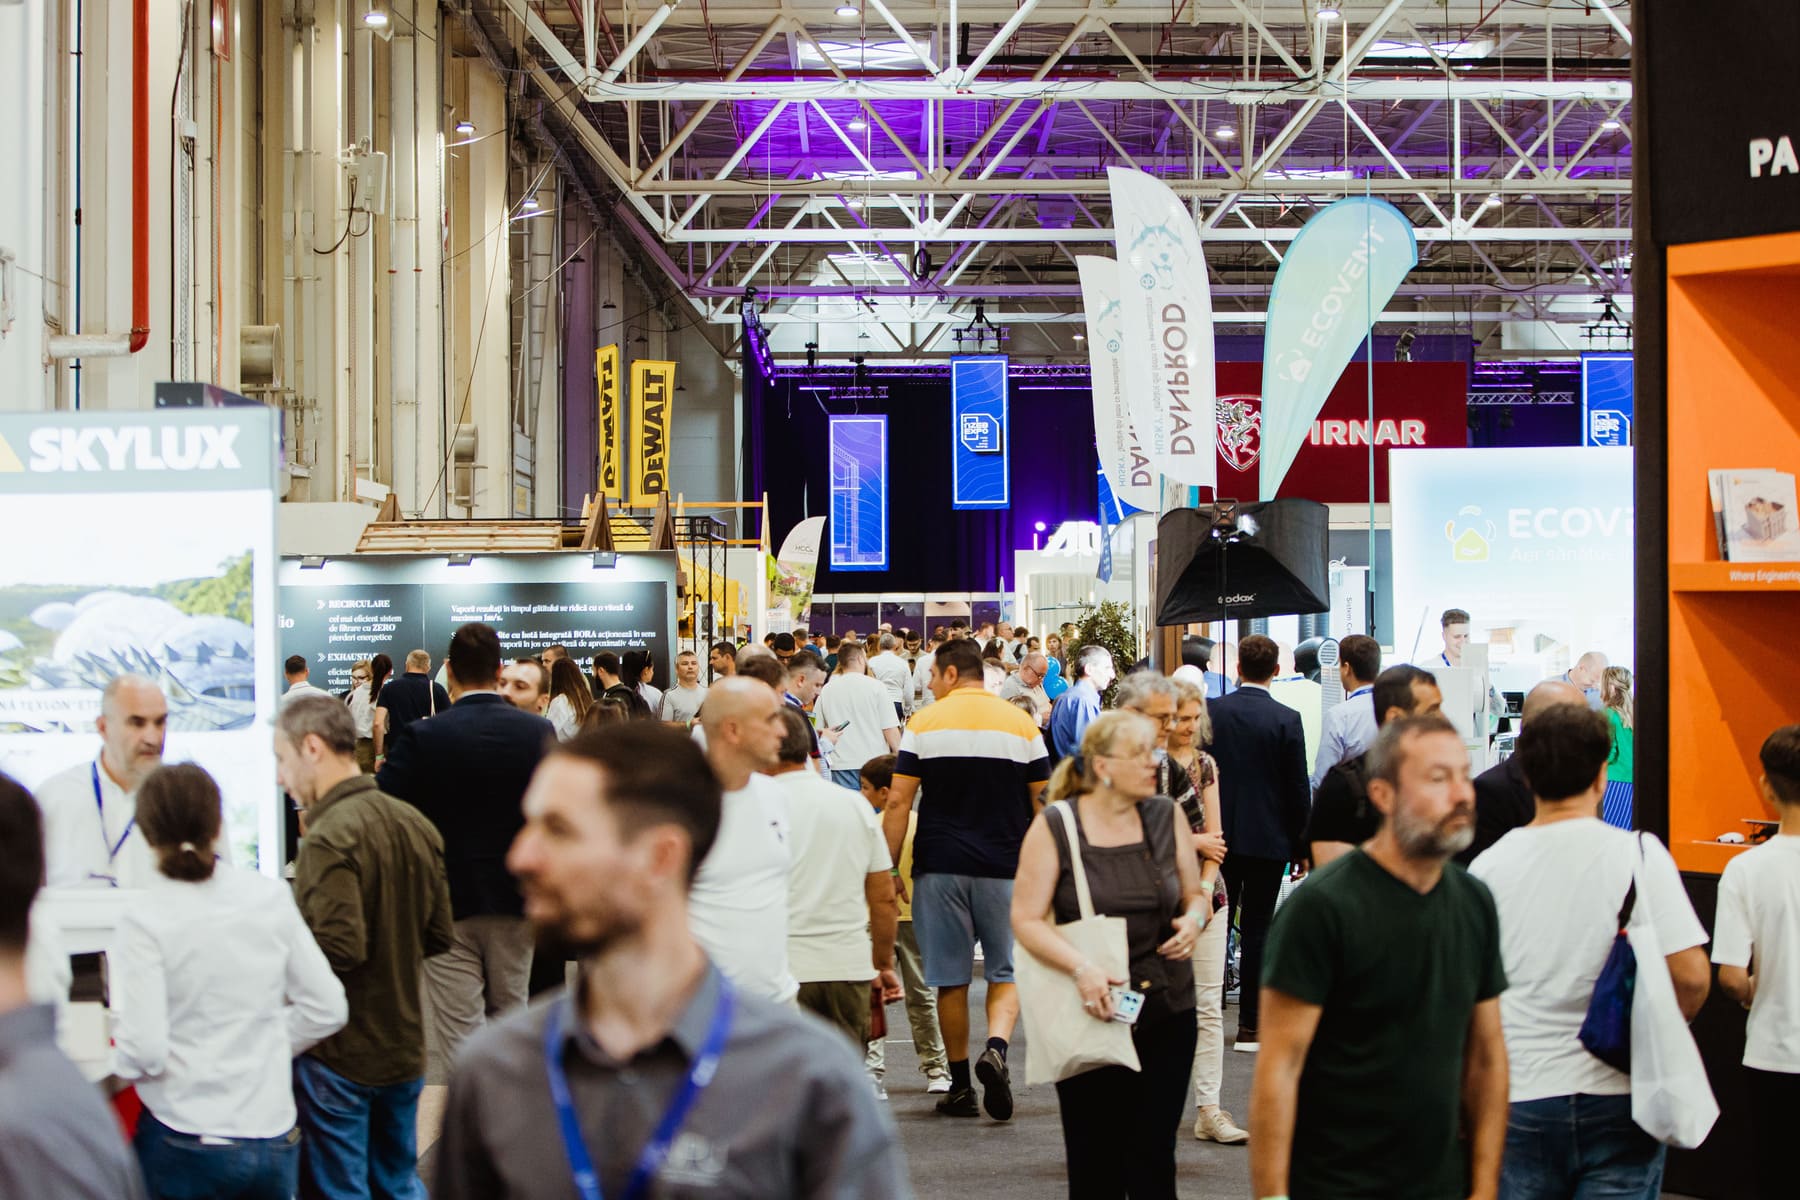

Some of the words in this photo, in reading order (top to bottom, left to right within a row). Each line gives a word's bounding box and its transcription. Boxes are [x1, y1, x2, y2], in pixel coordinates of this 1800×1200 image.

[1749, 136, 1800, 178] PA
[1302, 217, 1385, 348] ECOVENT
[29, 425, 241, 472] SKYLUX
[643, 369, 664, 495] DEWALT
[1311, 420, 1426, 446] IRNAR
[328, 599, 391, 609] RECIRCULARE
[372, 624, 396, 632] ZERO
[328, 653, 378, 661] EXHAUSTA
